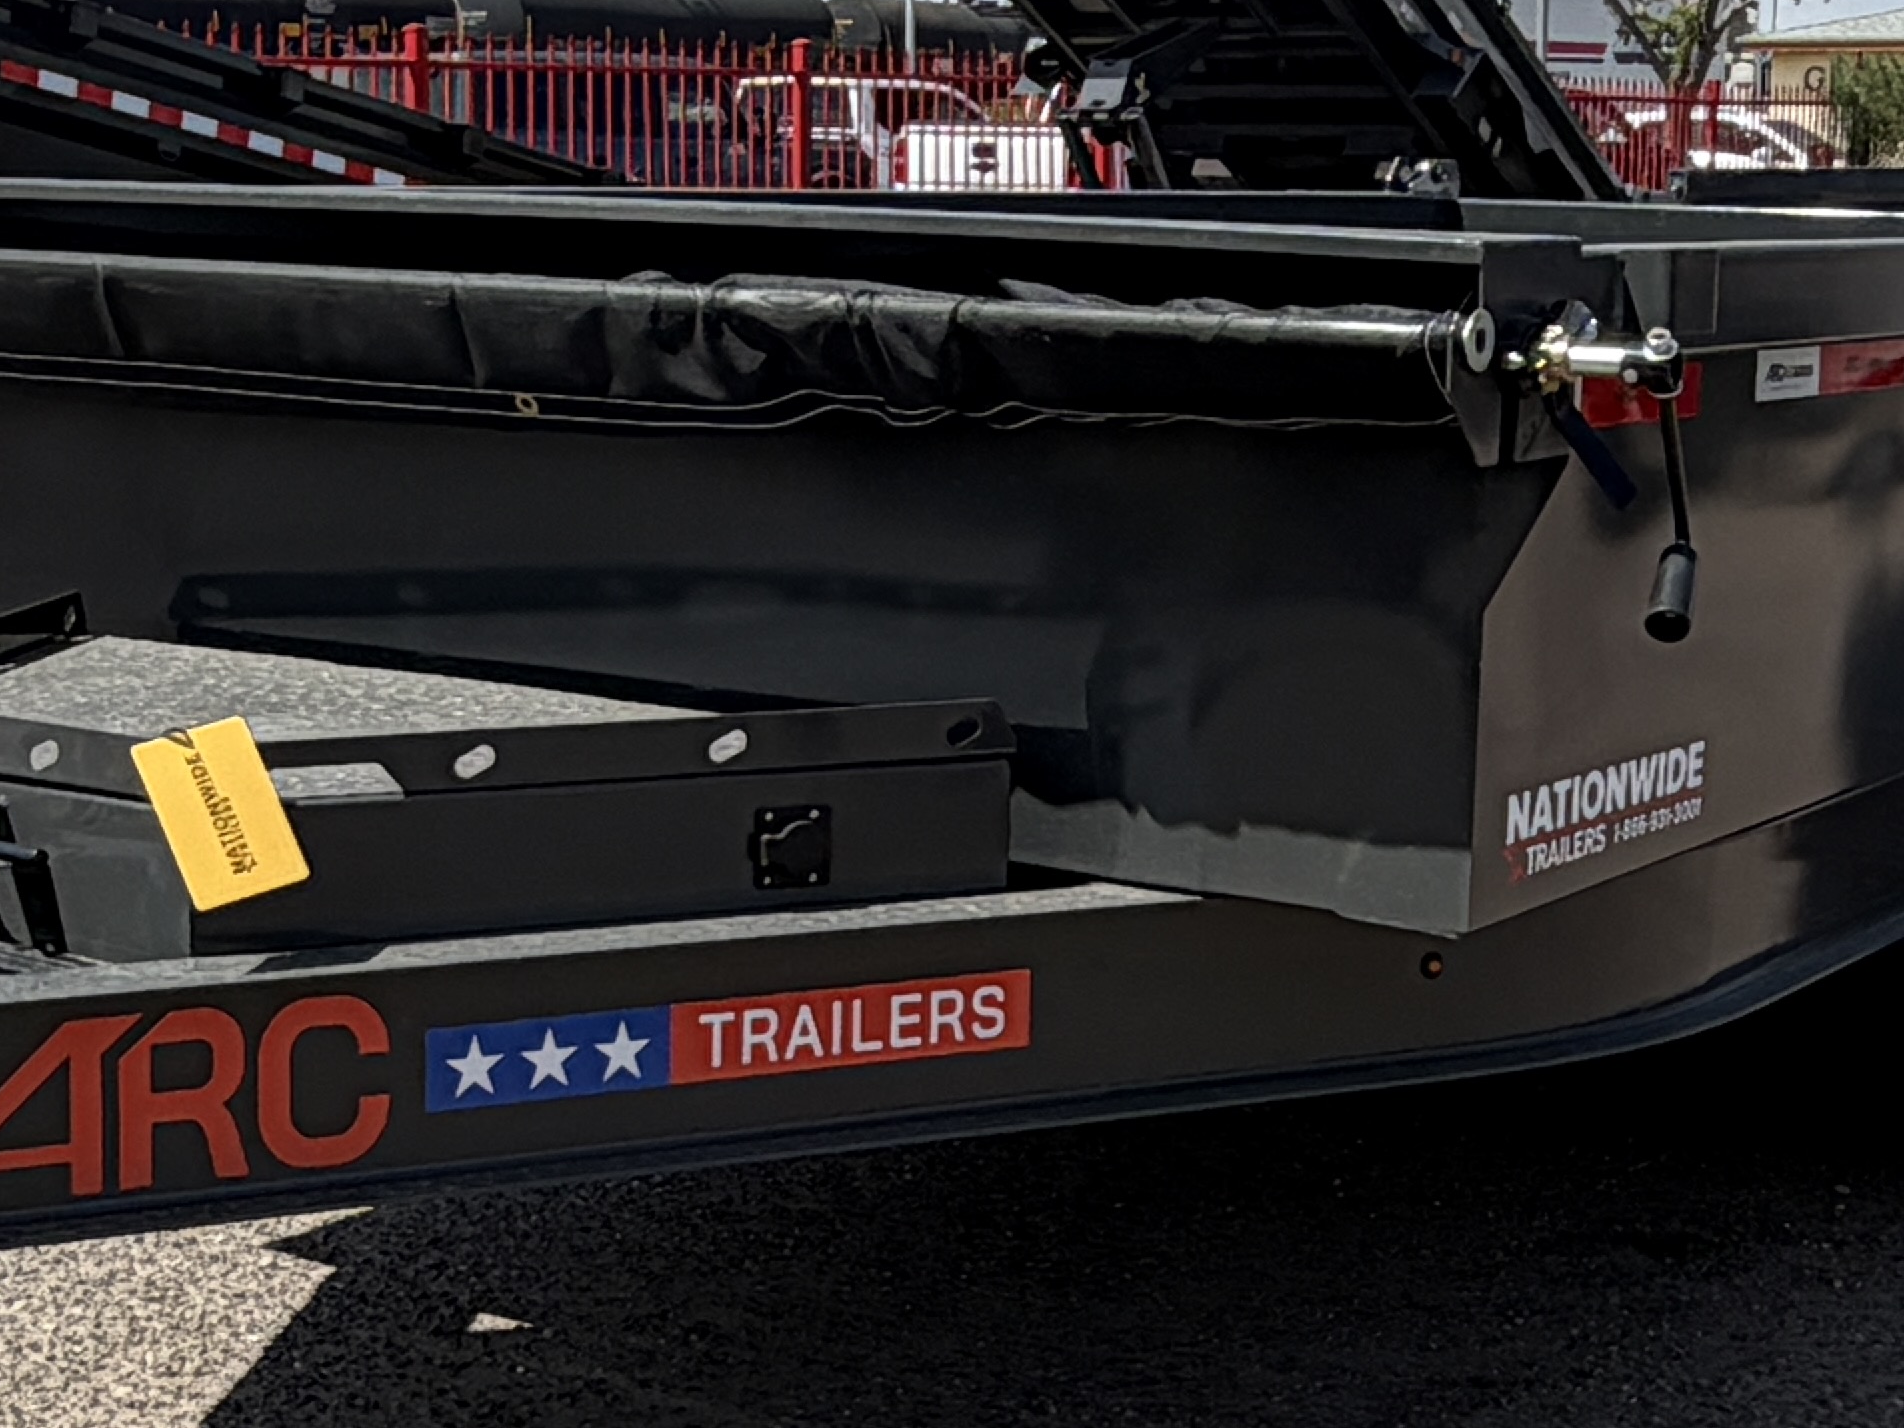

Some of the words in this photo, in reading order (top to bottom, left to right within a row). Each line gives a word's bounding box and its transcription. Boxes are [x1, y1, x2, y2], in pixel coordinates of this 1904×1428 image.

[1505, 740, 1706, 846] NATIONWIDE
[1525, 824, 1607, 876] TRAILERS
[697, 984, 1007, 1068] TRAILERS
